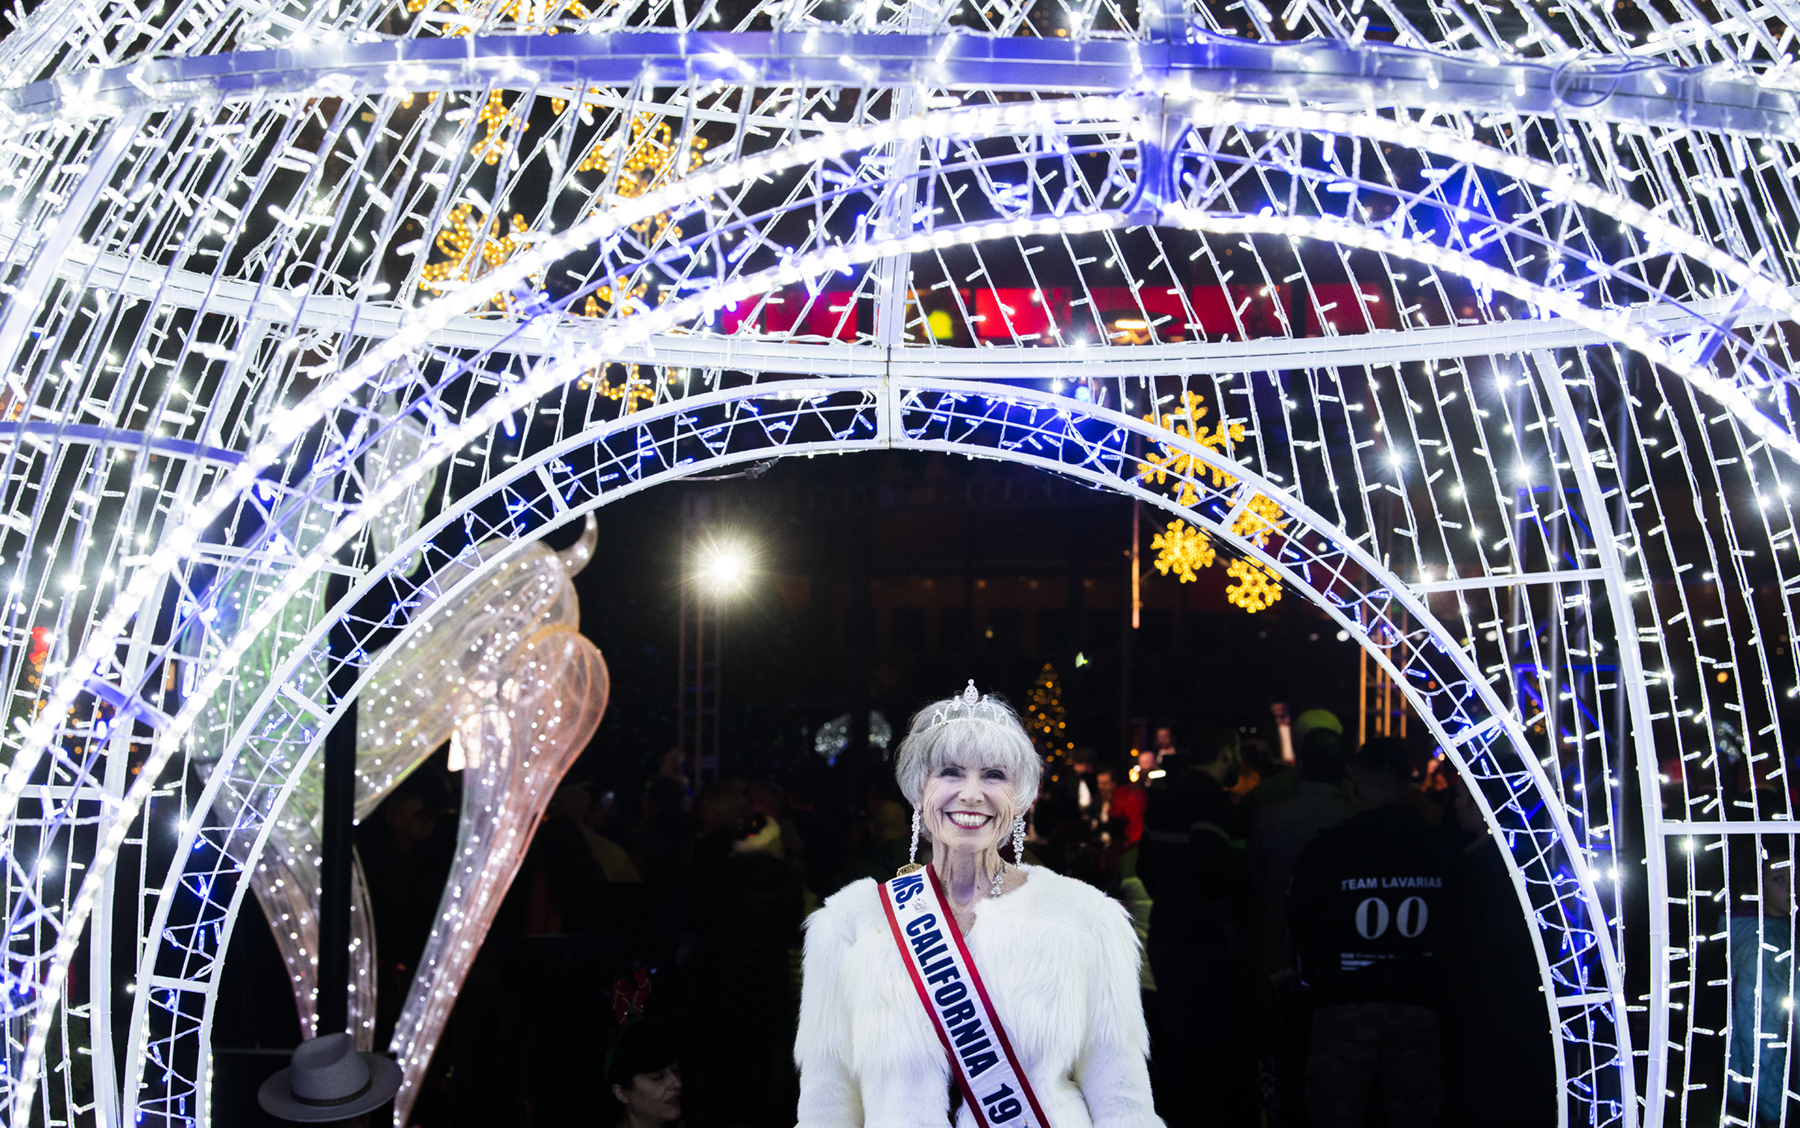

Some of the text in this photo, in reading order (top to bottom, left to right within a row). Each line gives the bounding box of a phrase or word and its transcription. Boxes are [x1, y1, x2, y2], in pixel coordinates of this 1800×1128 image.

[1341, 877, 1443, 891] TEAM LAVARIAS
[1355, 896, 1429, 940] 00
[891, 873, 1022, 1125] MS. CALIFORNIA 19
